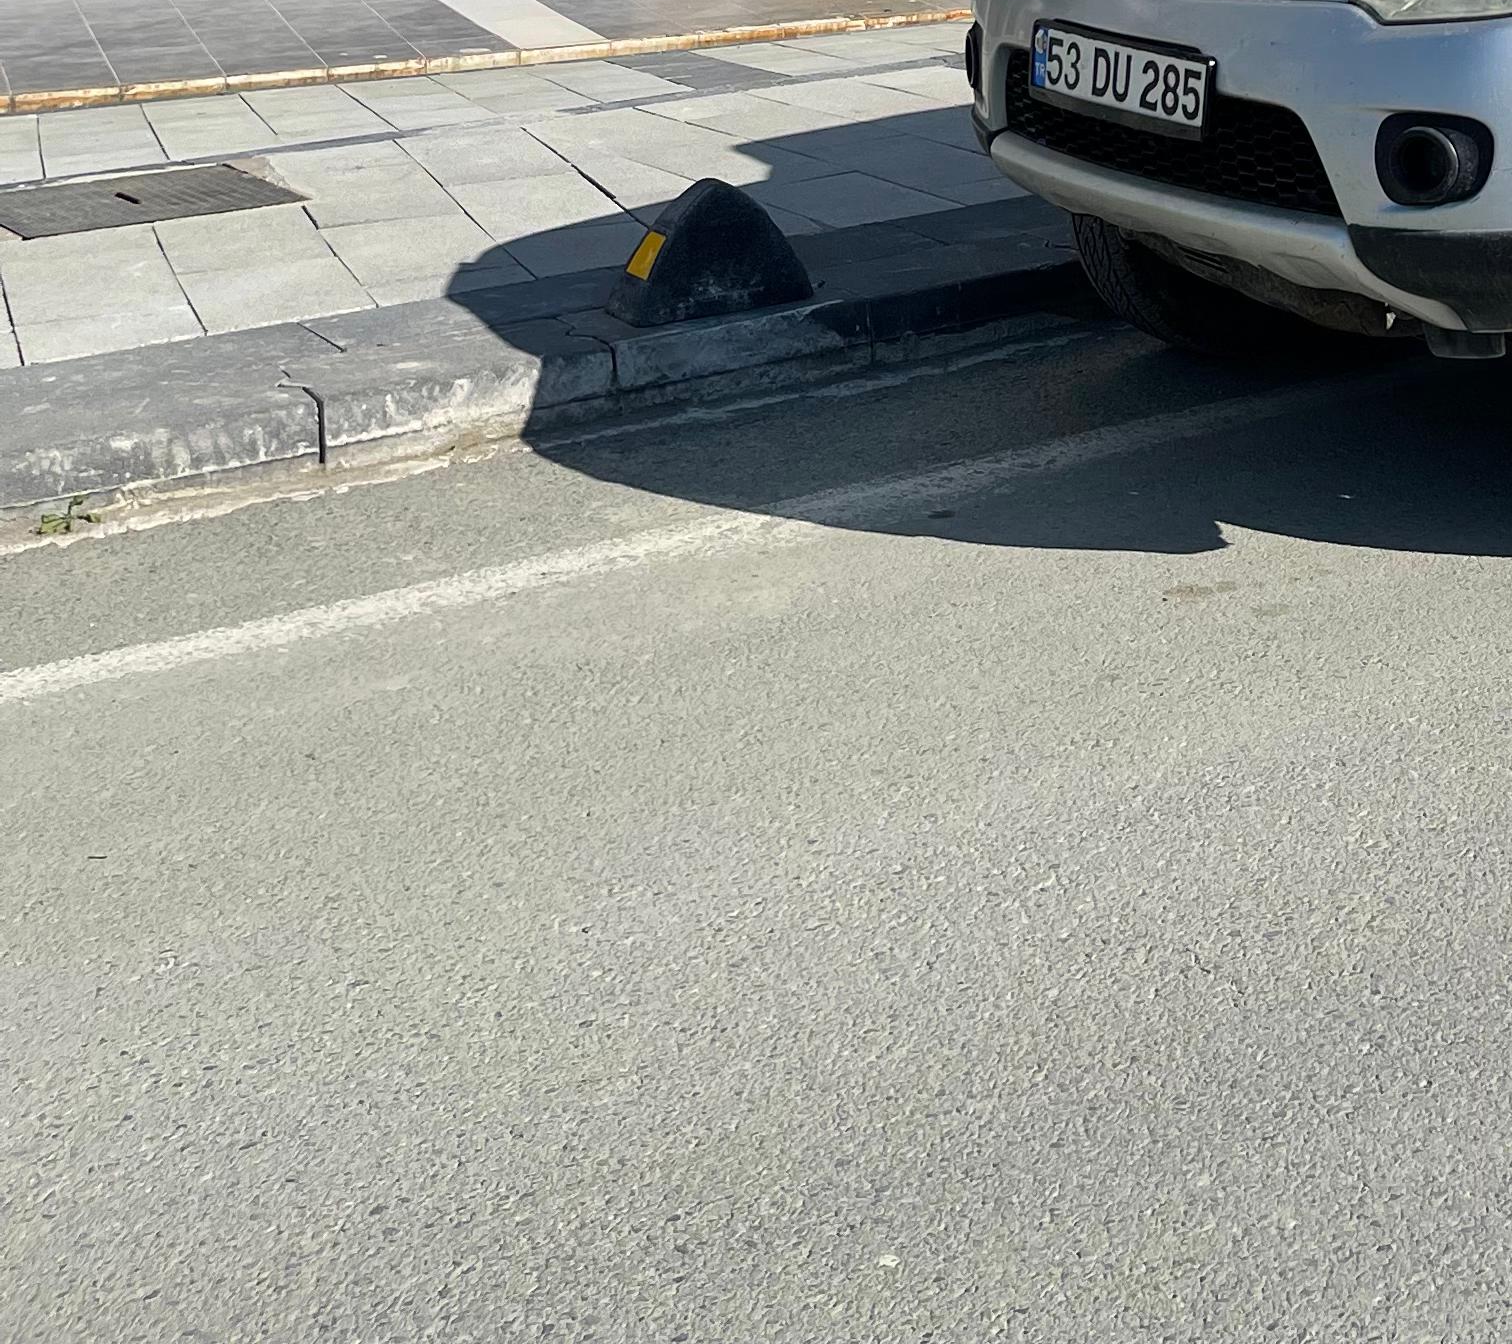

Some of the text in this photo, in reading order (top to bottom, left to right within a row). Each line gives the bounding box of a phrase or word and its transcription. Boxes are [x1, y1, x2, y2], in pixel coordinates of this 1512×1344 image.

[1046, 36, 1082, 90] 53
[1091, 46, 1133, 103] DU
[1139, 60, 1203, 121] 285
